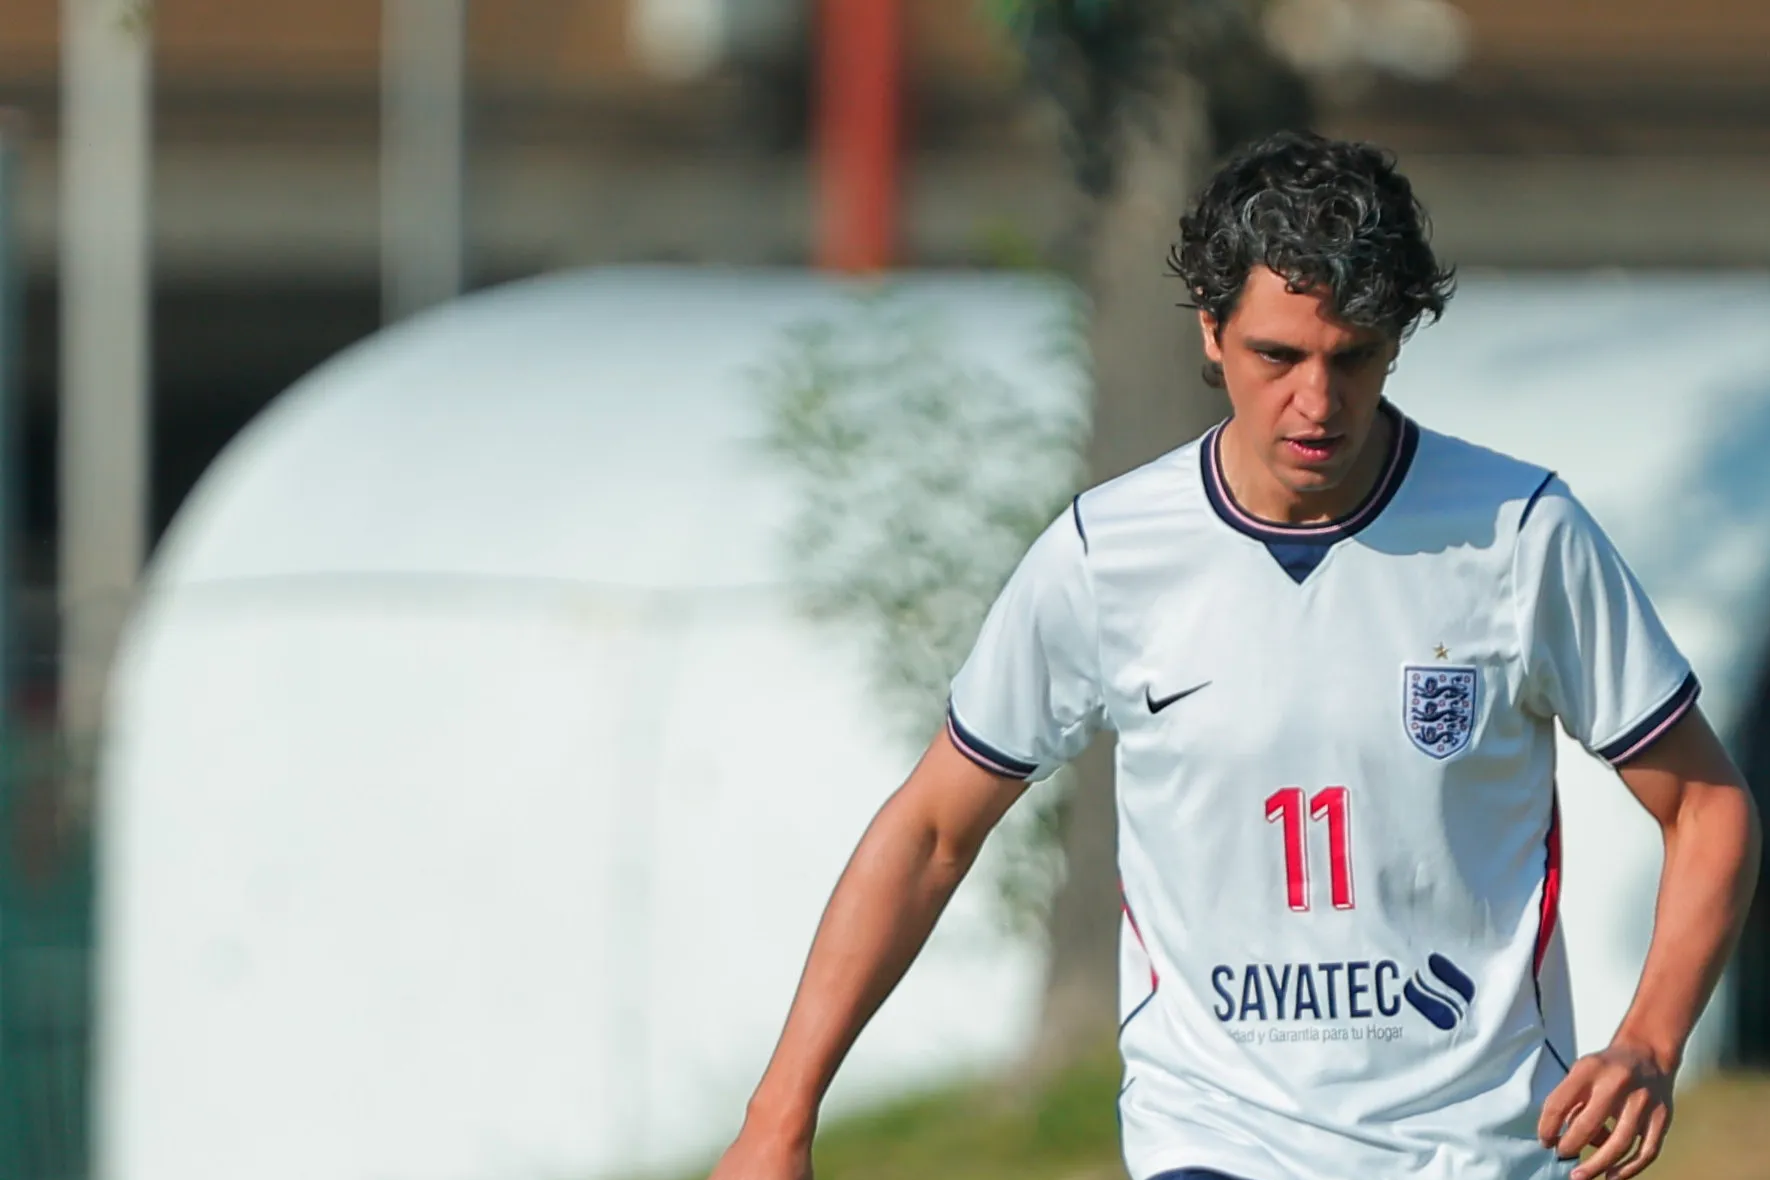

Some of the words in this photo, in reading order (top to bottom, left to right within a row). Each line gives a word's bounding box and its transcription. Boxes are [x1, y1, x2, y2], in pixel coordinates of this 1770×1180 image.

[1264, 786, 1355, 912] 11
[1211, 959, 1401, 1022] SAYATEC
[1257, 1030, 1266, 1046] y
[1322, 1027, 1349, 1044] para
[1351, 1026, 1364, 1040] tu
[1366, 1023, 1404, 1042] Hogar
